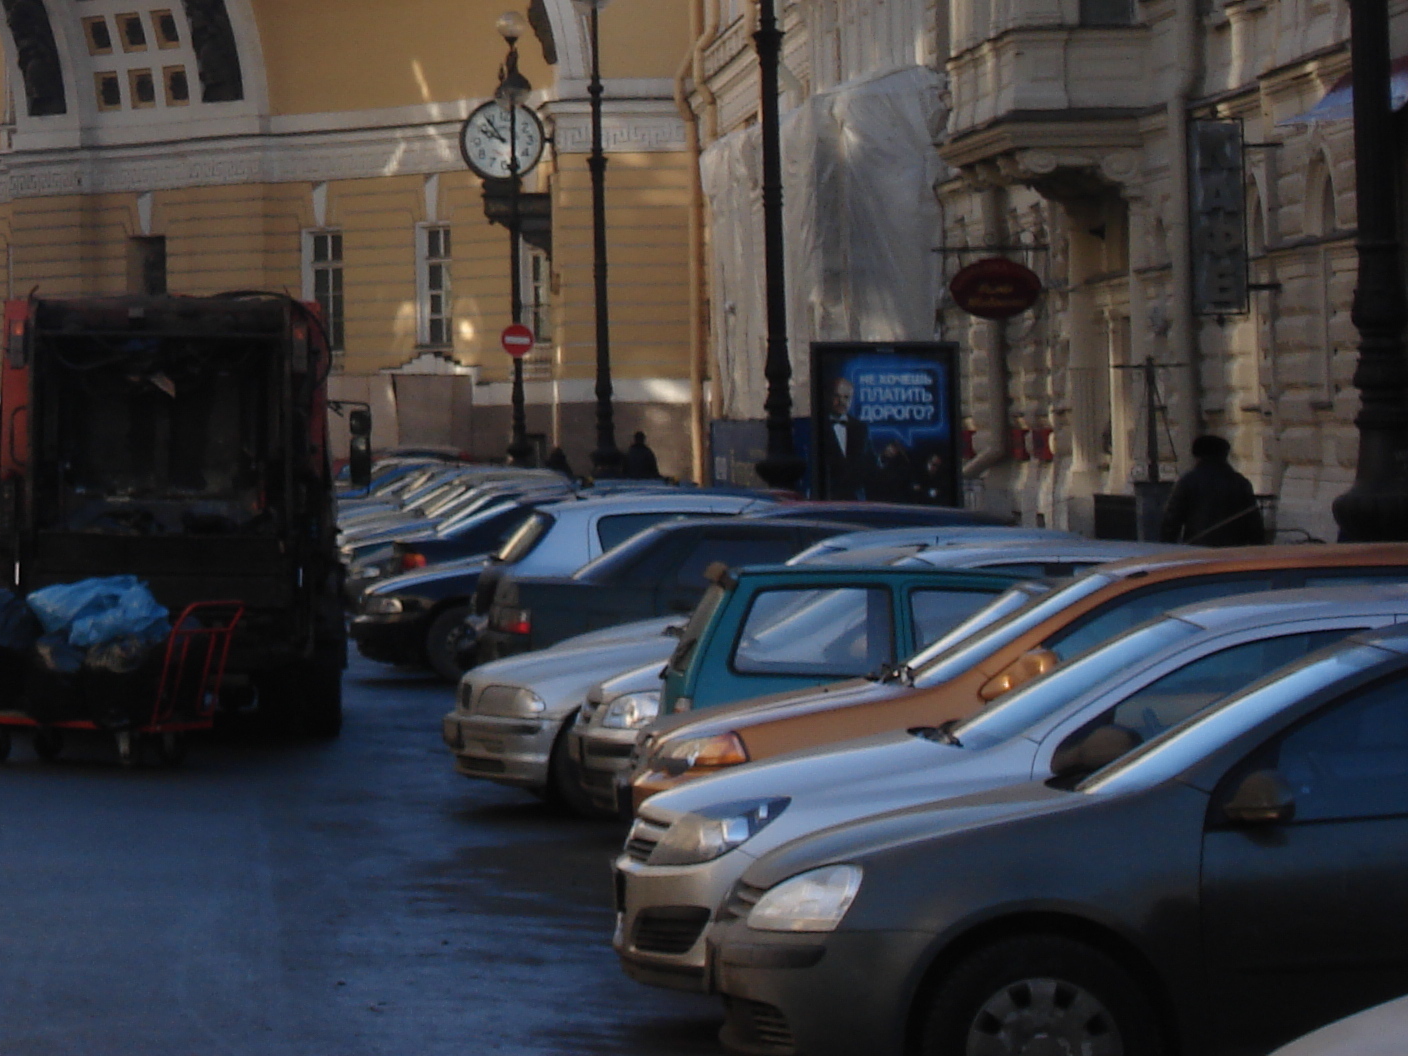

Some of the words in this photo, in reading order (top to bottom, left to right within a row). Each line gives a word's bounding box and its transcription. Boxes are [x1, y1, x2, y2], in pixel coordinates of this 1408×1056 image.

[521, 122, 529, 133] 2
[526, 135, 534, 146] 3
[479, 148, 486, 159] 8
[521, 148, 529, 156] 4
[489, 156, 497, 168] 7
[858, 374, 874, 385] НЕ
[879, 373, 933, 386] ХОЧЕШЬ
[859, 387, 934, 403] ПЛАТИТЬ
[859, 404, 935, 423] ДОРОГО?
